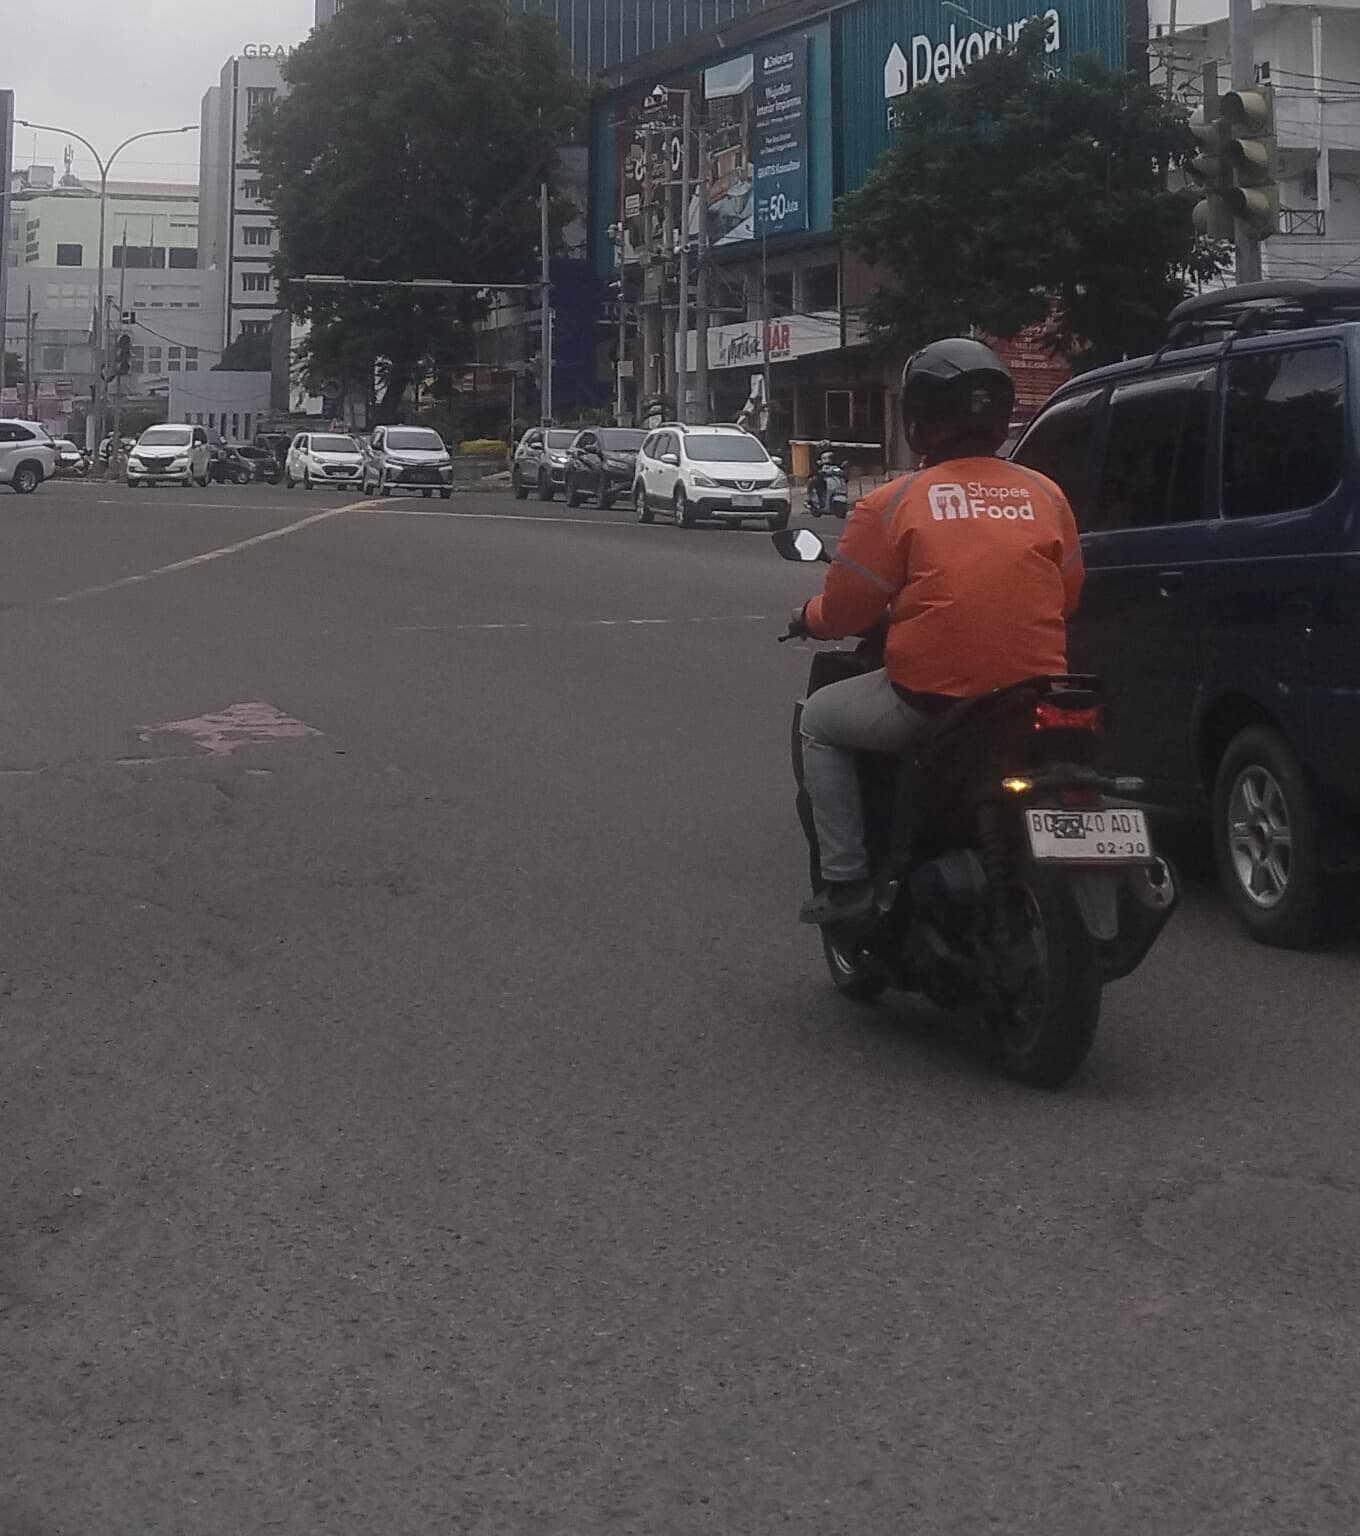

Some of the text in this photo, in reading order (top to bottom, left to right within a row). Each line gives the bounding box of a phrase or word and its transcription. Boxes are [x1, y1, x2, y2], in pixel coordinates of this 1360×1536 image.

[769, 193, 786, 222] 50
[967, 481, 1031, 502] Shopee
[969, 499, 1035, 521] Food
